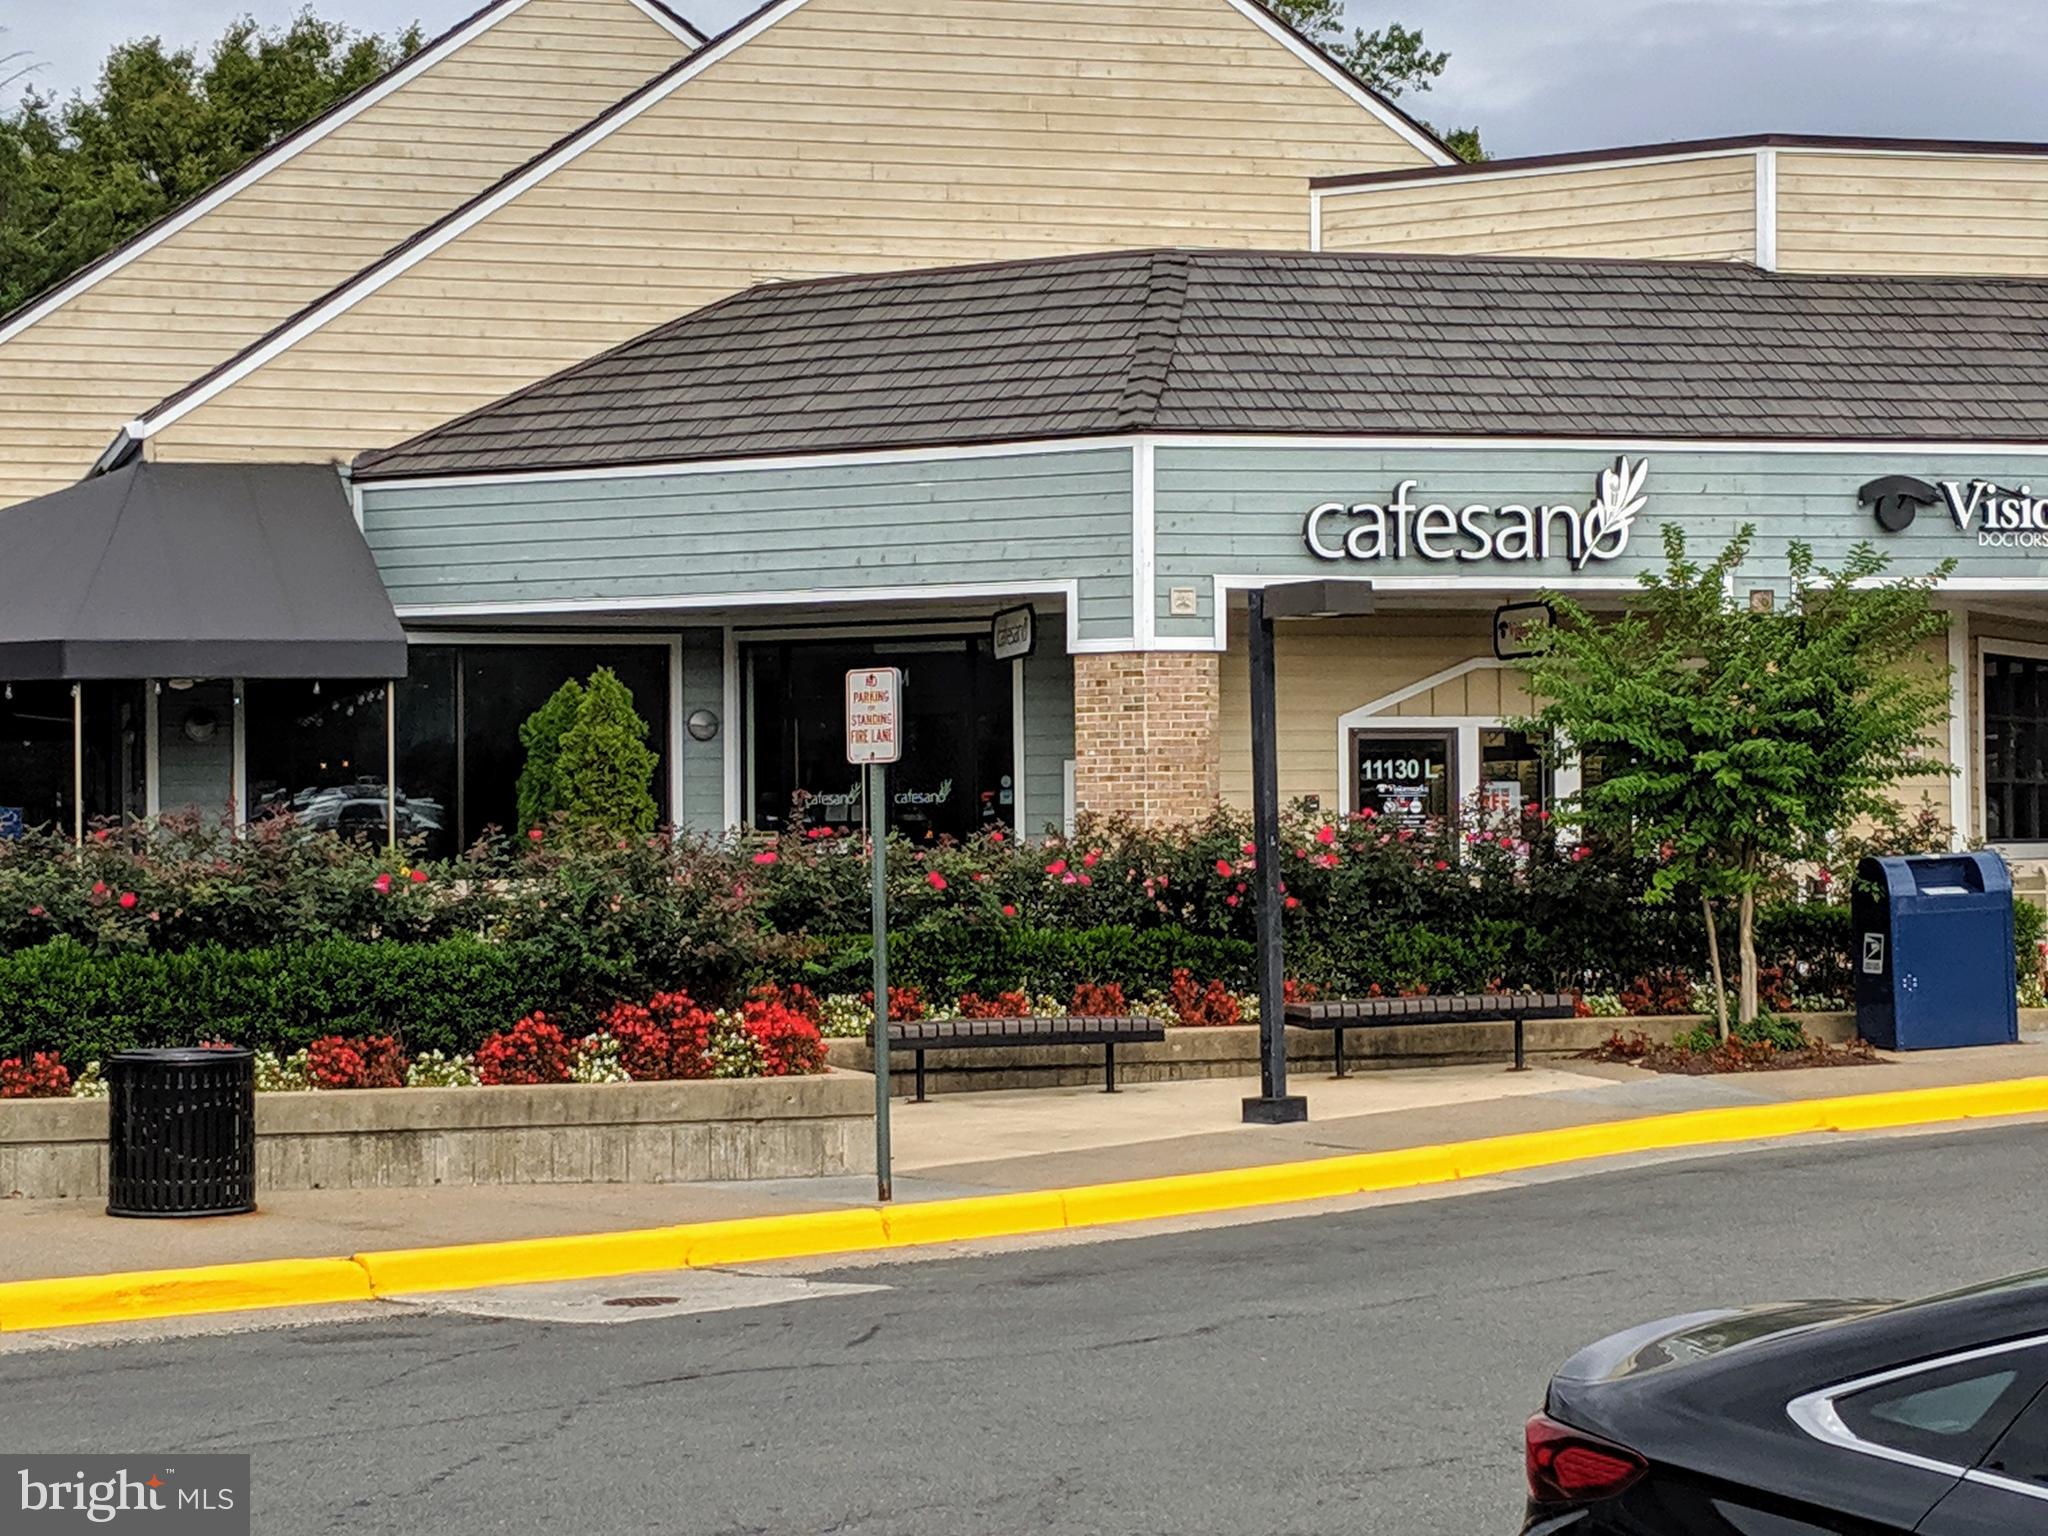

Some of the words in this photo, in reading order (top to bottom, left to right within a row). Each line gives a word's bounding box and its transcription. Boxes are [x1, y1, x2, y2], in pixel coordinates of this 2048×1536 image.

[1303, 478, 1632, 567] cafesano
[865, 675, 878, 687] NO
[853, 690, 889, 704] PARKING
[851, 713, 892, 727] STANDING
[850, 729, 868, 743] FIRE
[872, 728, 893, 743] LANE
[1362, 758, 1420, 780] 11130
[1424, 758, 1440, 779] L
[894, 787, 948, 805] cafesano
